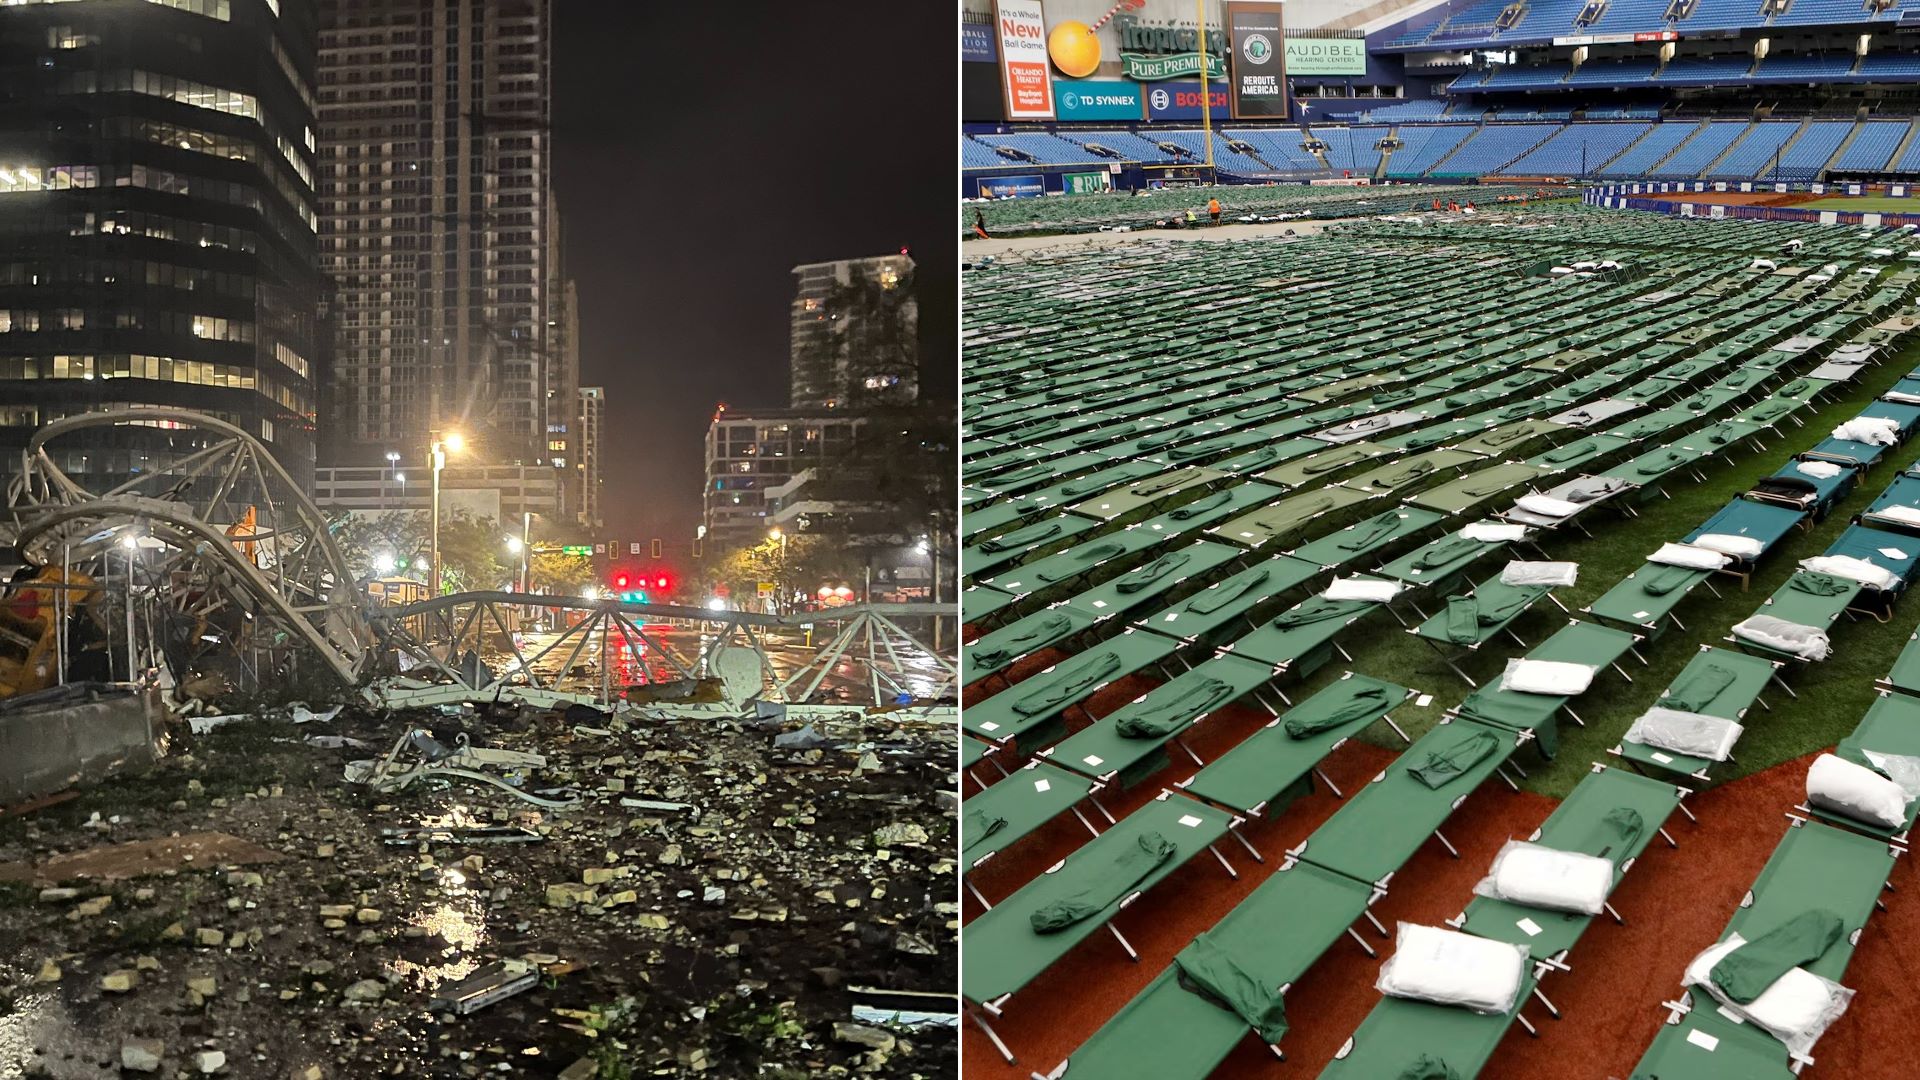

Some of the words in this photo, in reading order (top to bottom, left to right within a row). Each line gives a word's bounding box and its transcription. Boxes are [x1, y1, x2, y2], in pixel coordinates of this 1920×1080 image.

[1000, 9, 1011, 17] It's
[1017, 11, 1040, 19] Whole
[1002, 19, 1041, 38] New
[1004, 40, 1020, 48] Ball
[1020, 41, 1045, 50] Game.
[1286, 45, 1365, 56] AUDIBEL
[1011, 67, 1044, 76] ORLANDO
[1131, 61, 1162, 76] PURE
[1164, 58, 1215, 73] PREMIUM
[1243, 76, 1276, 85] REROUTE
[1241, 85, 1279, 95] AMERICAS
[1080, 96, 1094, 105] TD
[1096, 96, 1135, 106] SYNNEX
[1175, 92, 1227, 107] BOSCH
